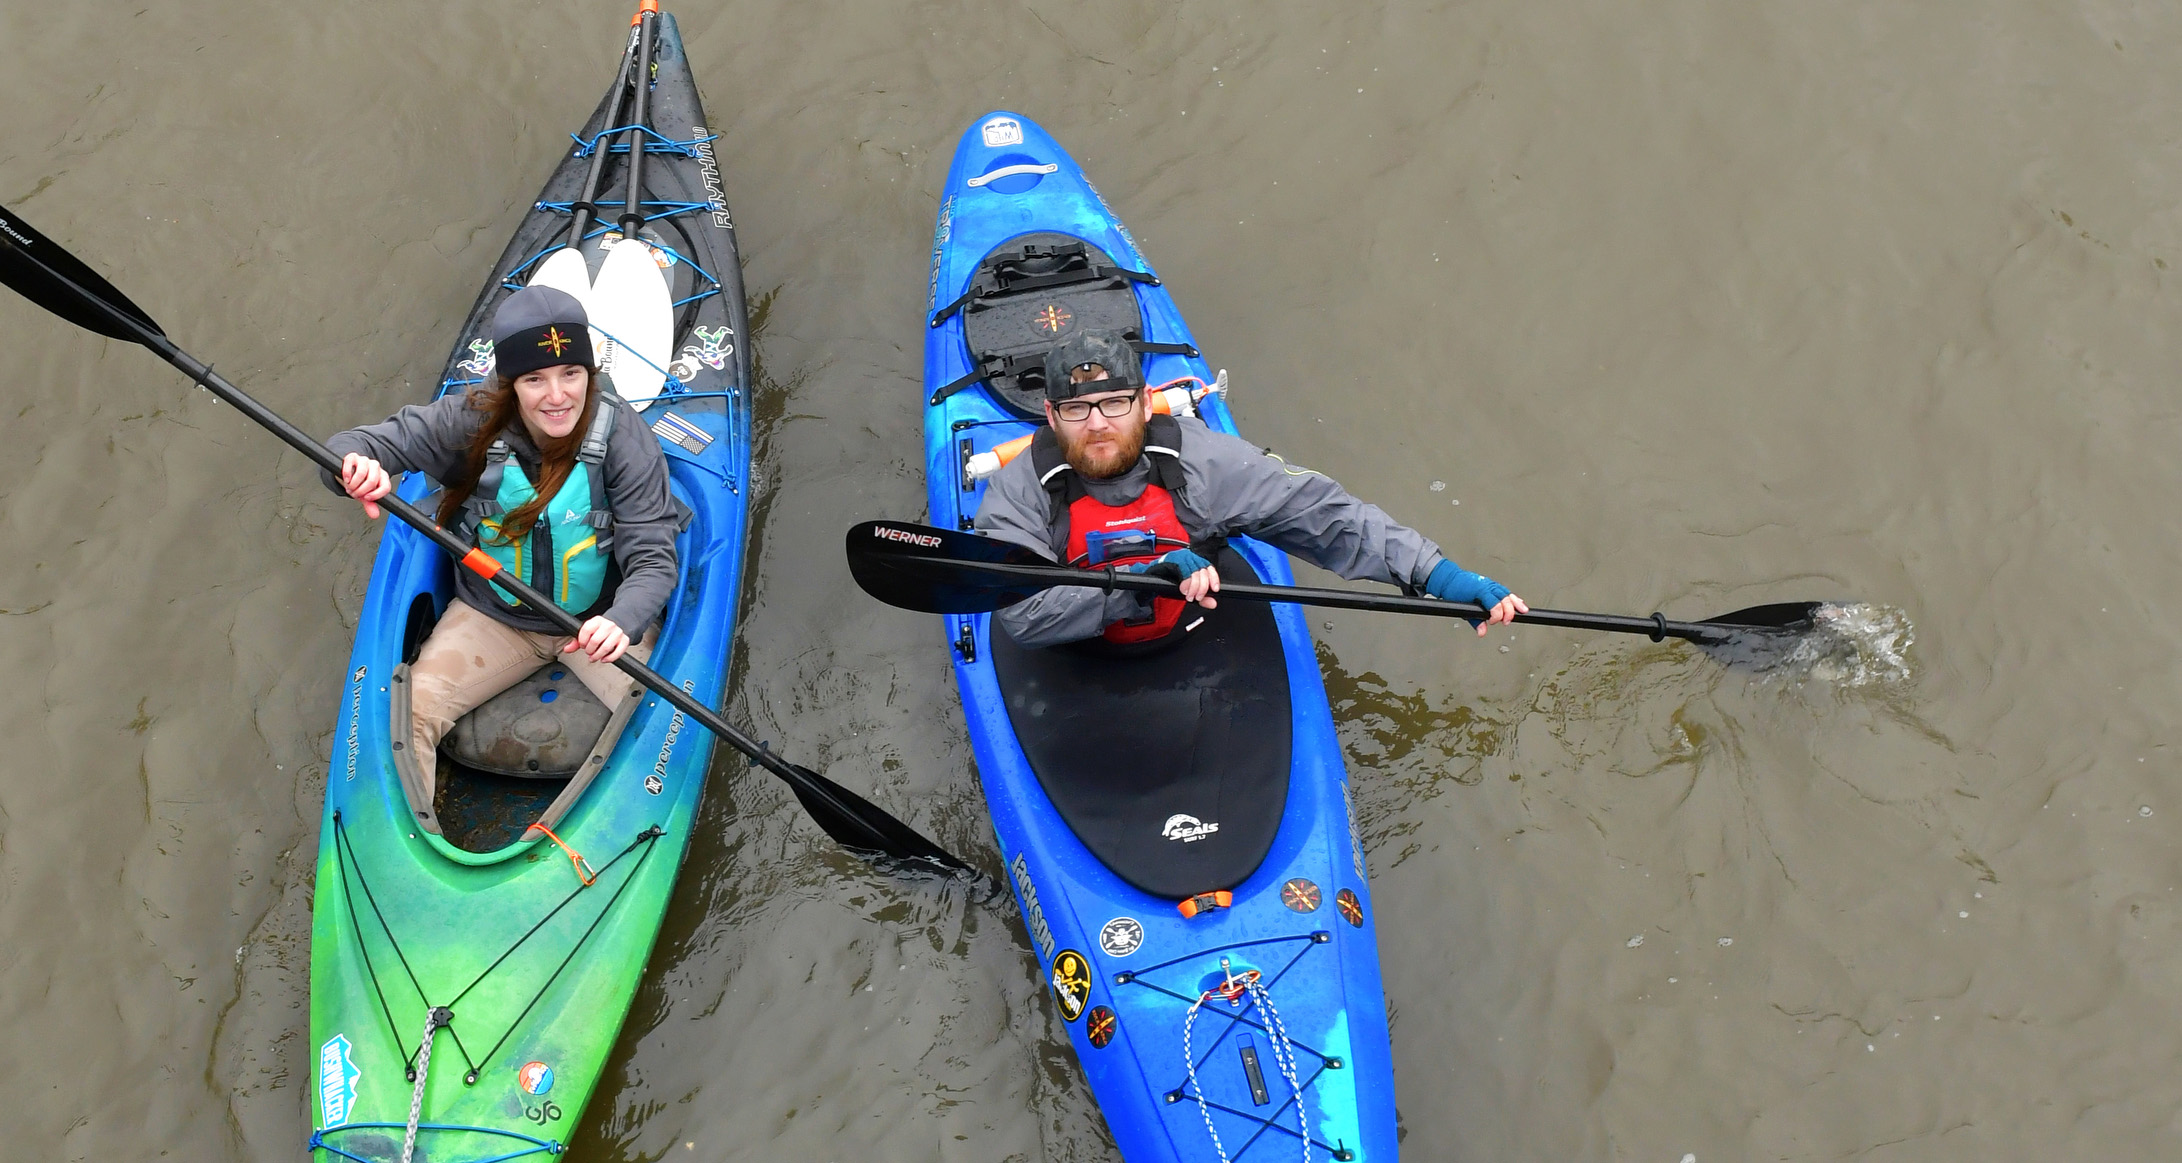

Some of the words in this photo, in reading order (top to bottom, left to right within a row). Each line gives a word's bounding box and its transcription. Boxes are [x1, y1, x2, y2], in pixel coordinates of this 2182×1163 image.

[874, 525, 942, 549] WERNER
[346, 684, 363, 782] perception
[653, 679, 696, 778] percepn
[322, 1042, 345, 1126] BUSHWHACKER
